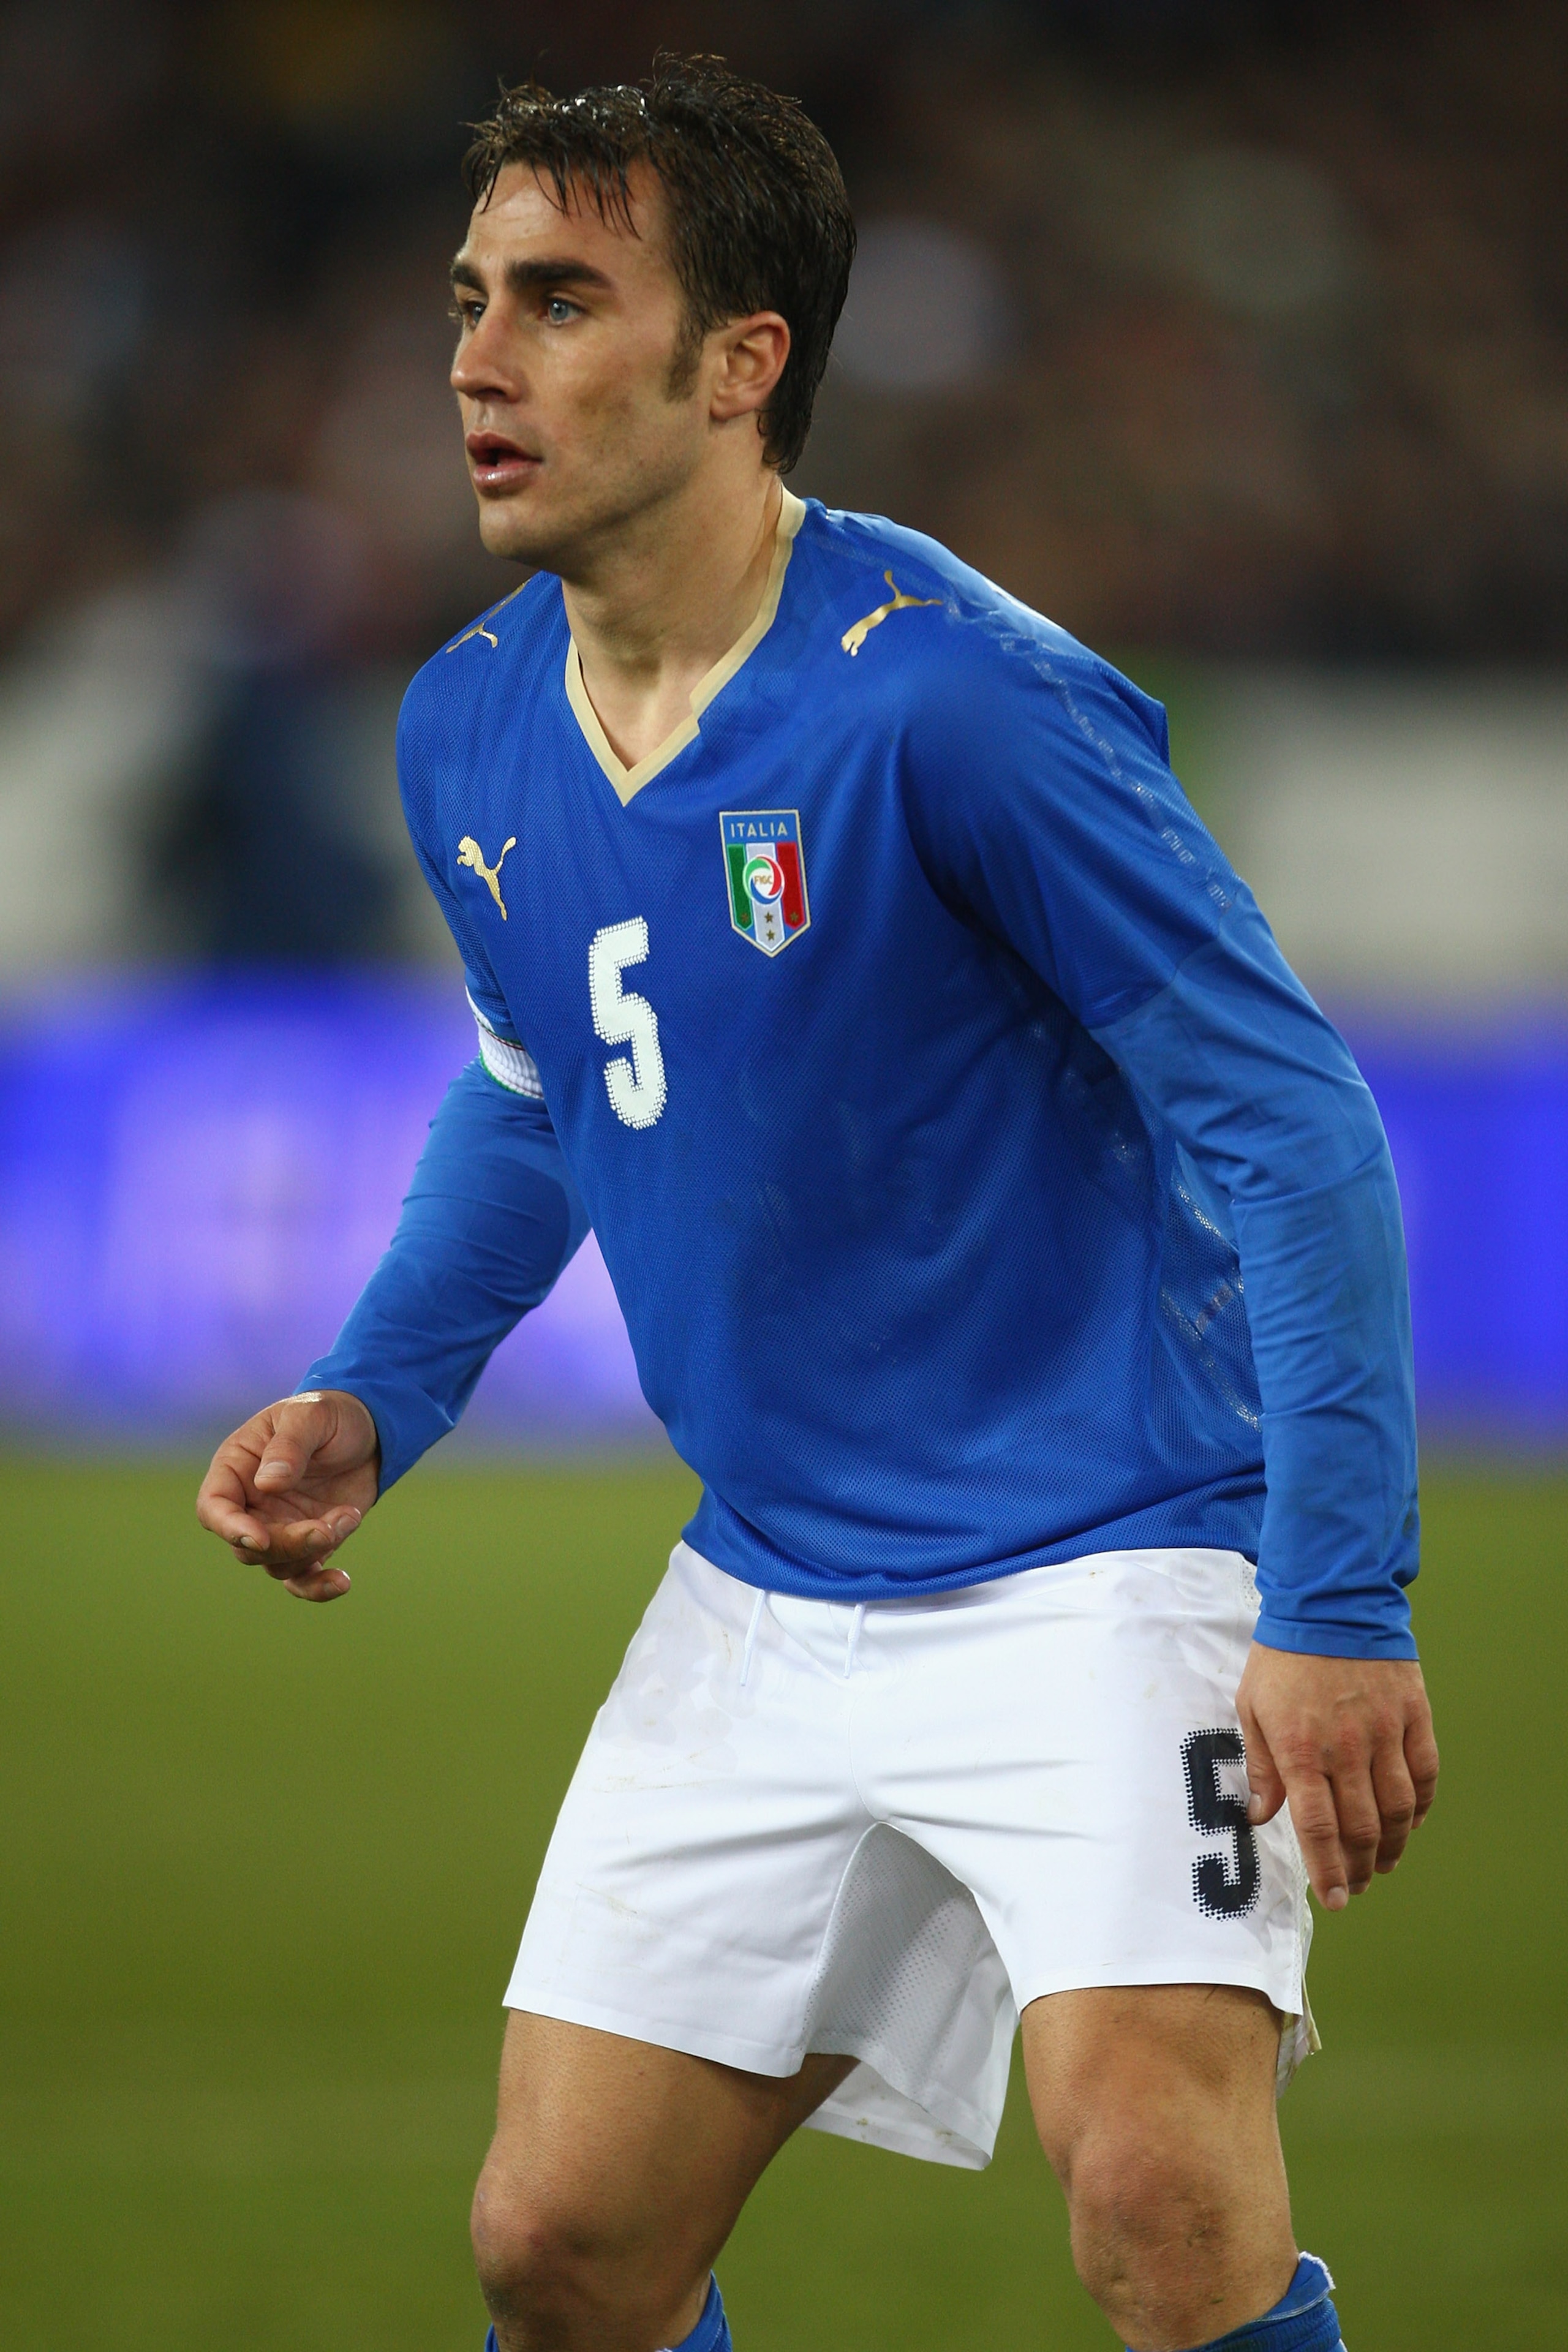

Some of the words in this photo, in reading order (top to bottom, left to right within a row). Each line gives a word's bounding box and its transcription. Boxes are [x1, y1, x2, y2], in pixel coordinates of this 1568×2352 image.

[731, 821, 788, 837] ITALIA
[589, 915, 668, 1129] 5
[1180, 1727, 1262, 1921] 5
